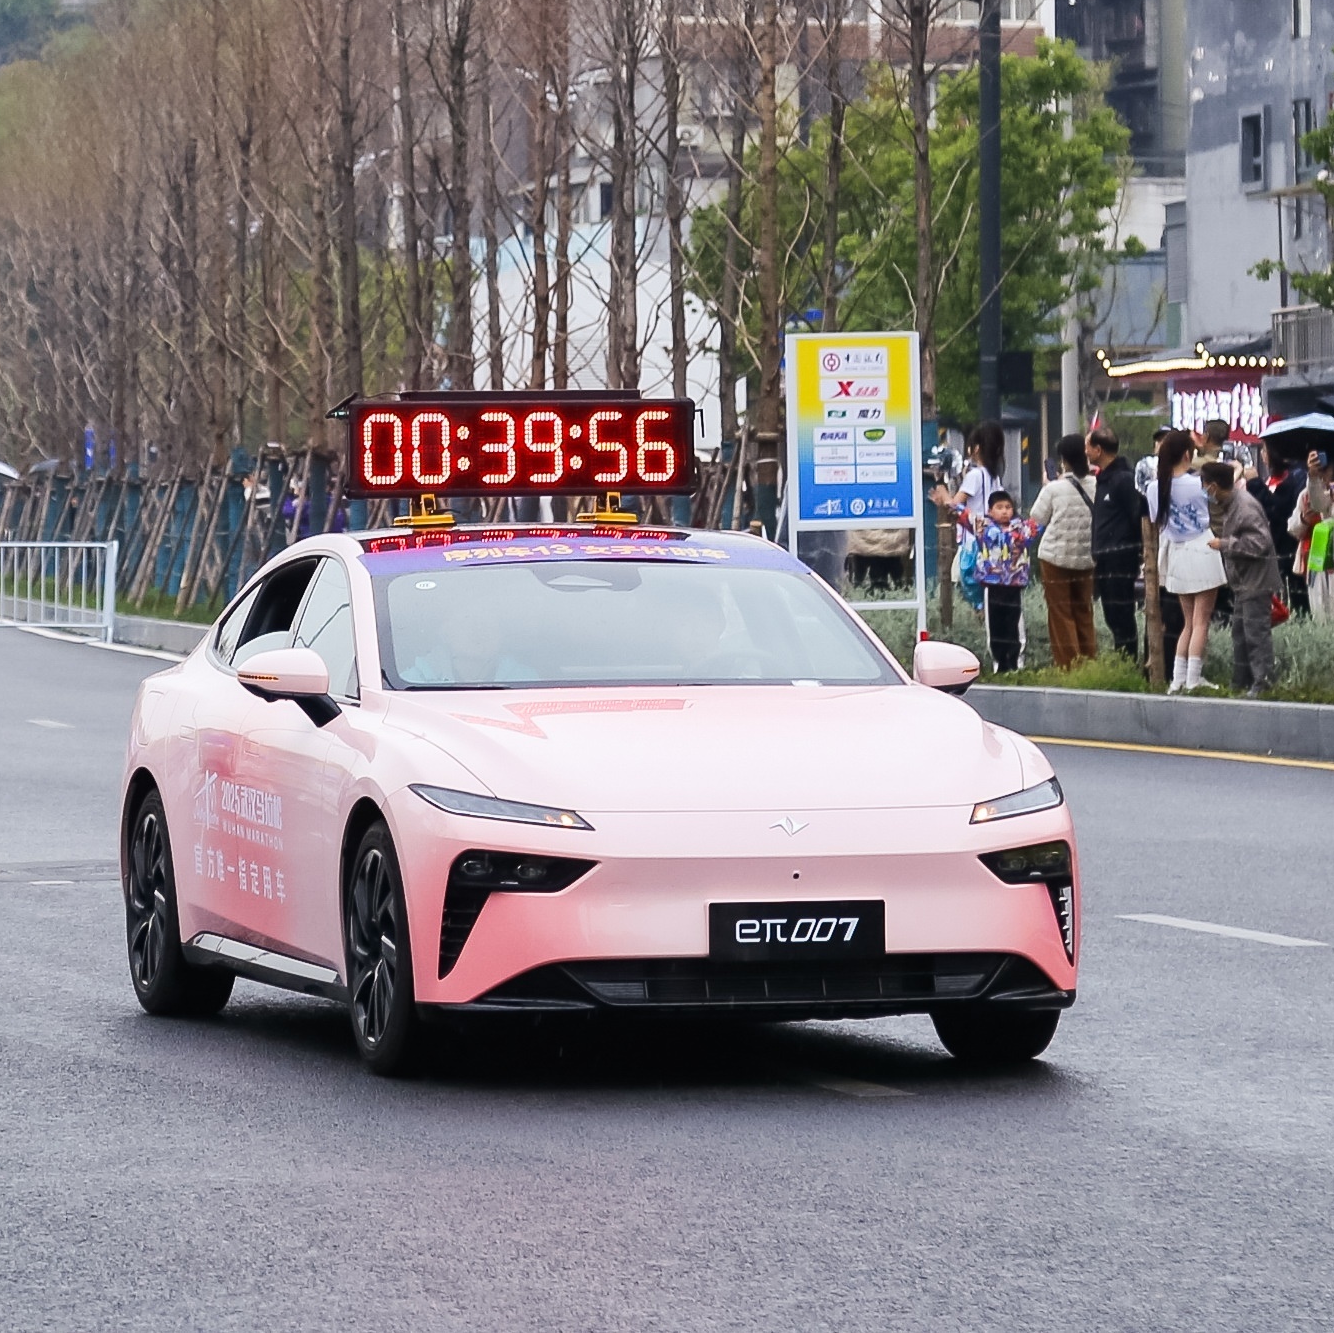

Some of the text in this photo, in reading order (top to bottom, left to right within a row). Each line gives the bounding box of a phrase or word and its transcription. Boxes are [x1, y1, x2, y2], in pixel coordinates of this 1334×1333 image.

[857, 408, 882, 420] 魔力
[362, 410, 676, 486] 00:39:56
[579, 545, 731, 561] 女子计时车
[221, 780, 283, 831] 2025武汉马拉松
[222, 818, 245, 840] WUHAN
[245, 828, 284, 852] MARATHON
[193, 842, 287, 905] 官方唯一指定用车
